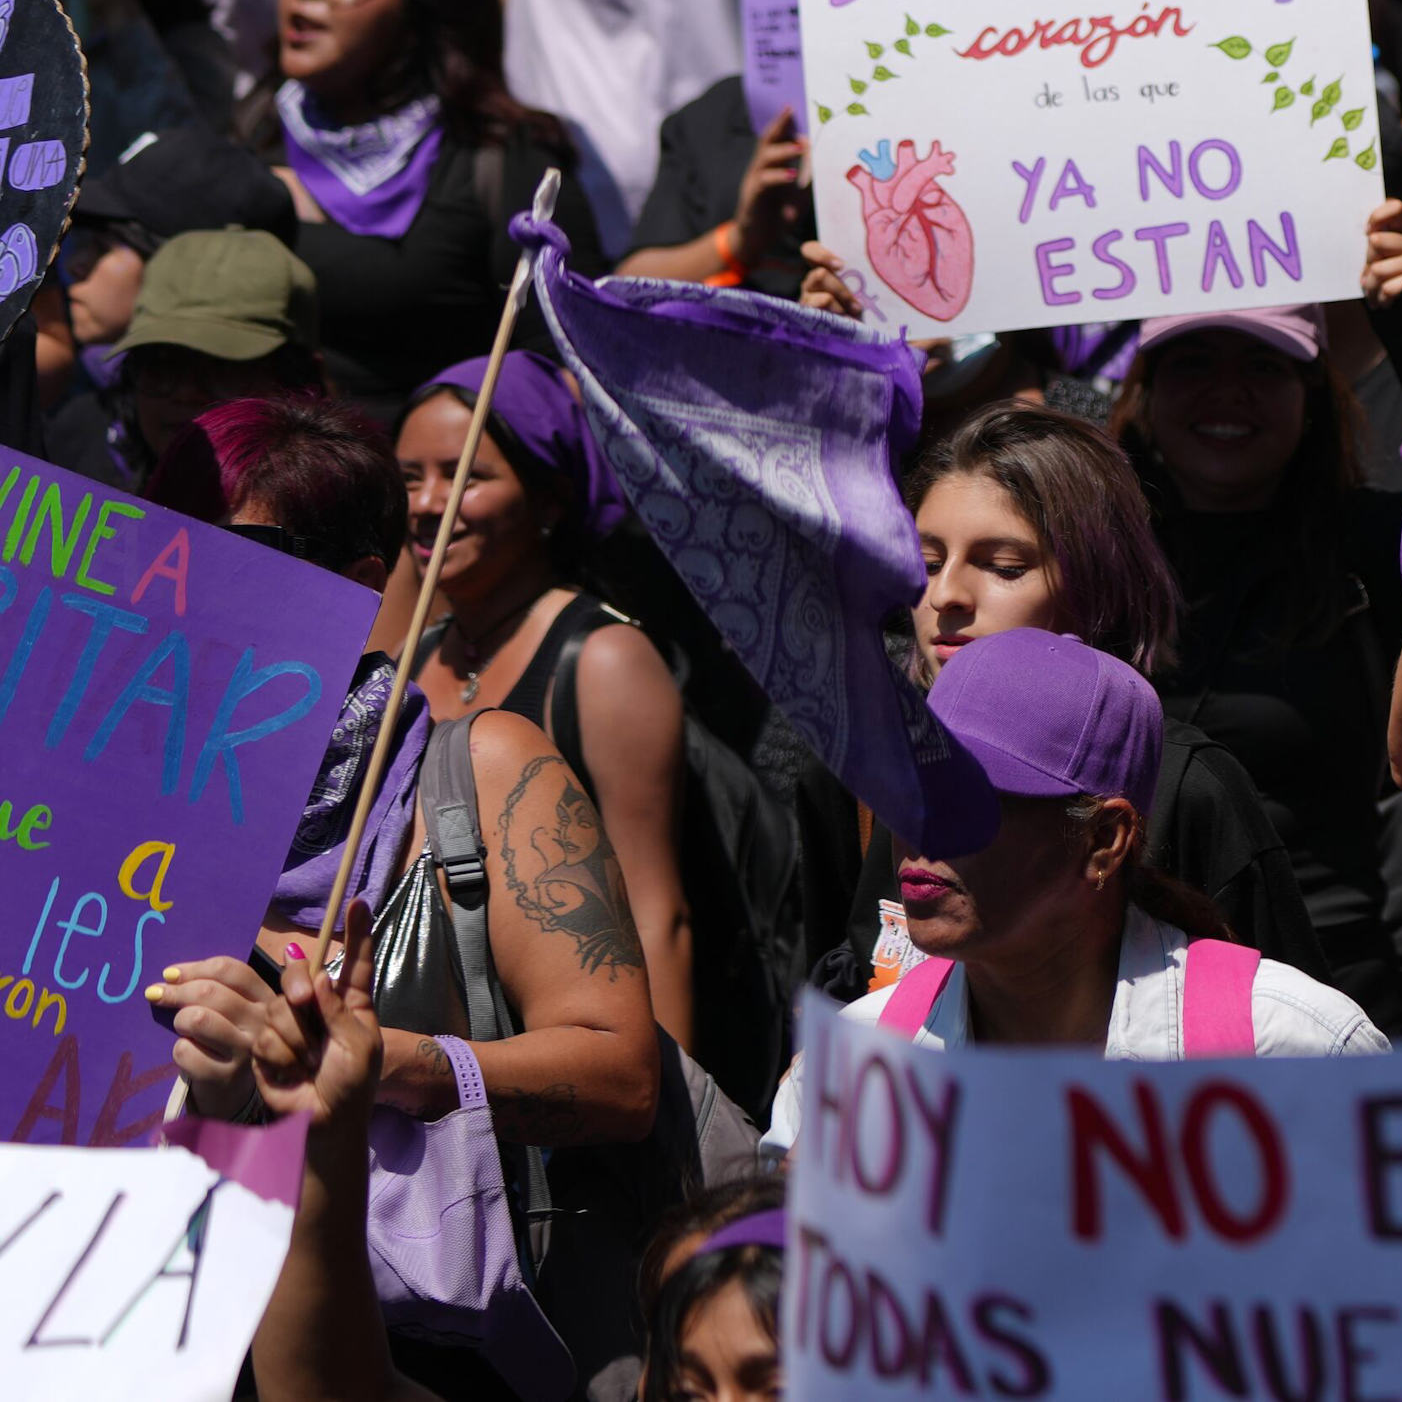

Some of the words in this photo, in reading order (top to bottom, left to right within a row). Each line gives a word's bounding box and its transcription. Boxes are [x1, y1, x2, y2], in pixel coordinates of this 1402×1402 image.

[950, 1, 1198, 70] corazón
[1033, 82, 1065, 110] de
[1080, 74, 1122, 105] las
[1137, 78, 1181, 107] que
[1009, 157, 1098, 225] YA
[1136, 138, 1244, 202] NO
[1034, 210, 1304, 309] ESTAN
[131, 527, 193, 615] A
[0, 566, 324, 826] ITAR
[117, 840, 175, 912] a
[21, 875, 167, 1005] les
[812, 1030, 966, 1238] HOY
[1064, 1072, 1295, 1247] NO
